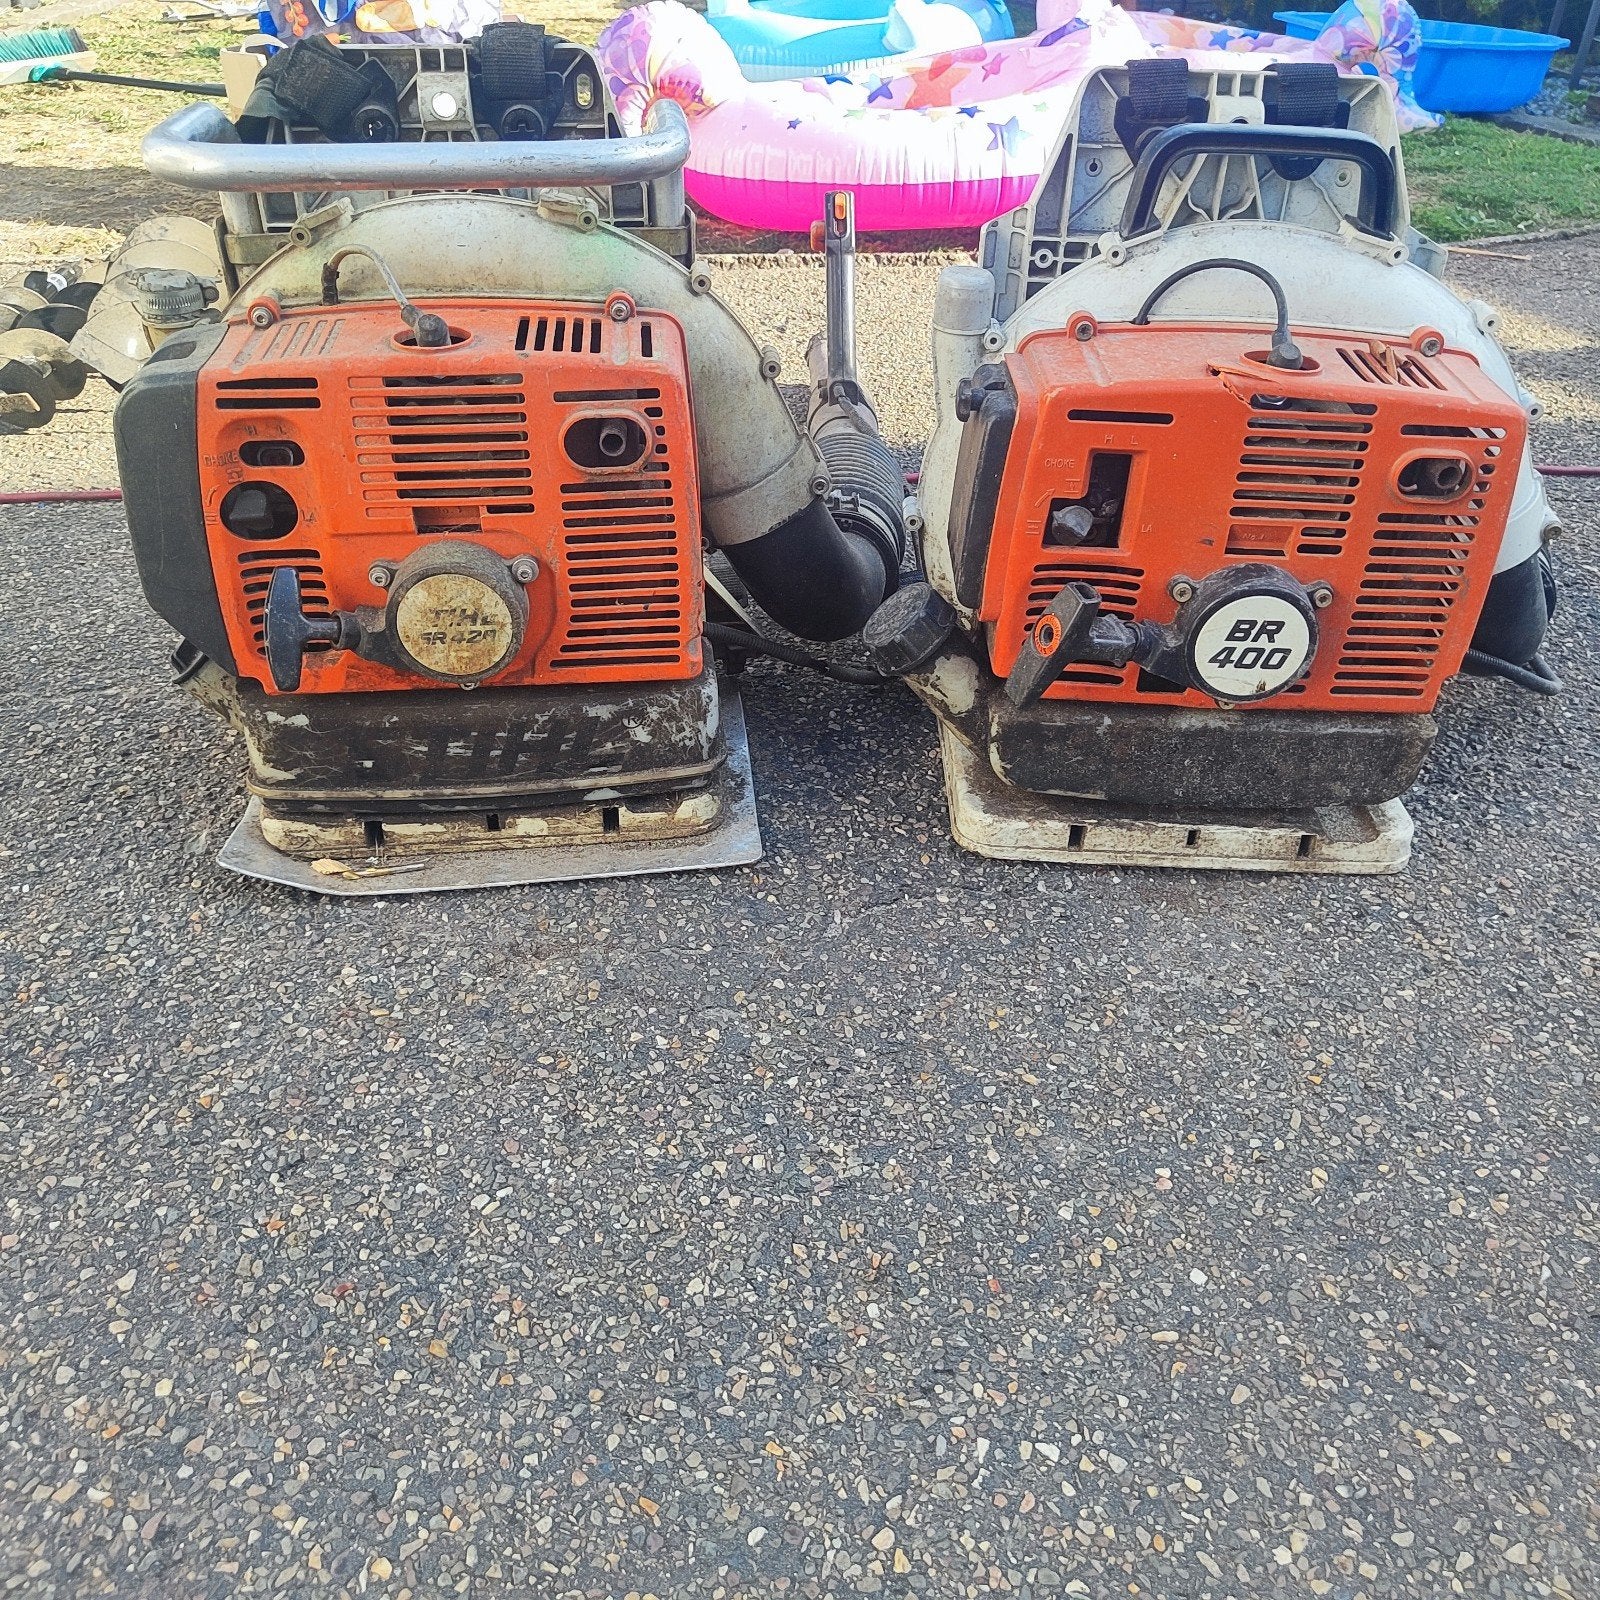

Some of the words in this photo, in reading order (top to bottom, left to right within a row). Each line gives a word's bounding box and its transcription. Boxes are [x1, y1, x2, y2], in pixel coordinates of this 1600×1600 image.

[1103, 434, 1114, 444] H
[1130, 435, 1138, 445] L
[1044, 457, 1076, 469] CHOKE
[1141, 523, 1153, 534] LA
[422, 606, 499, 628] TIHL
[1224, 618, 1286, 644] BR
[1207, 646, 1293, 671] 400
